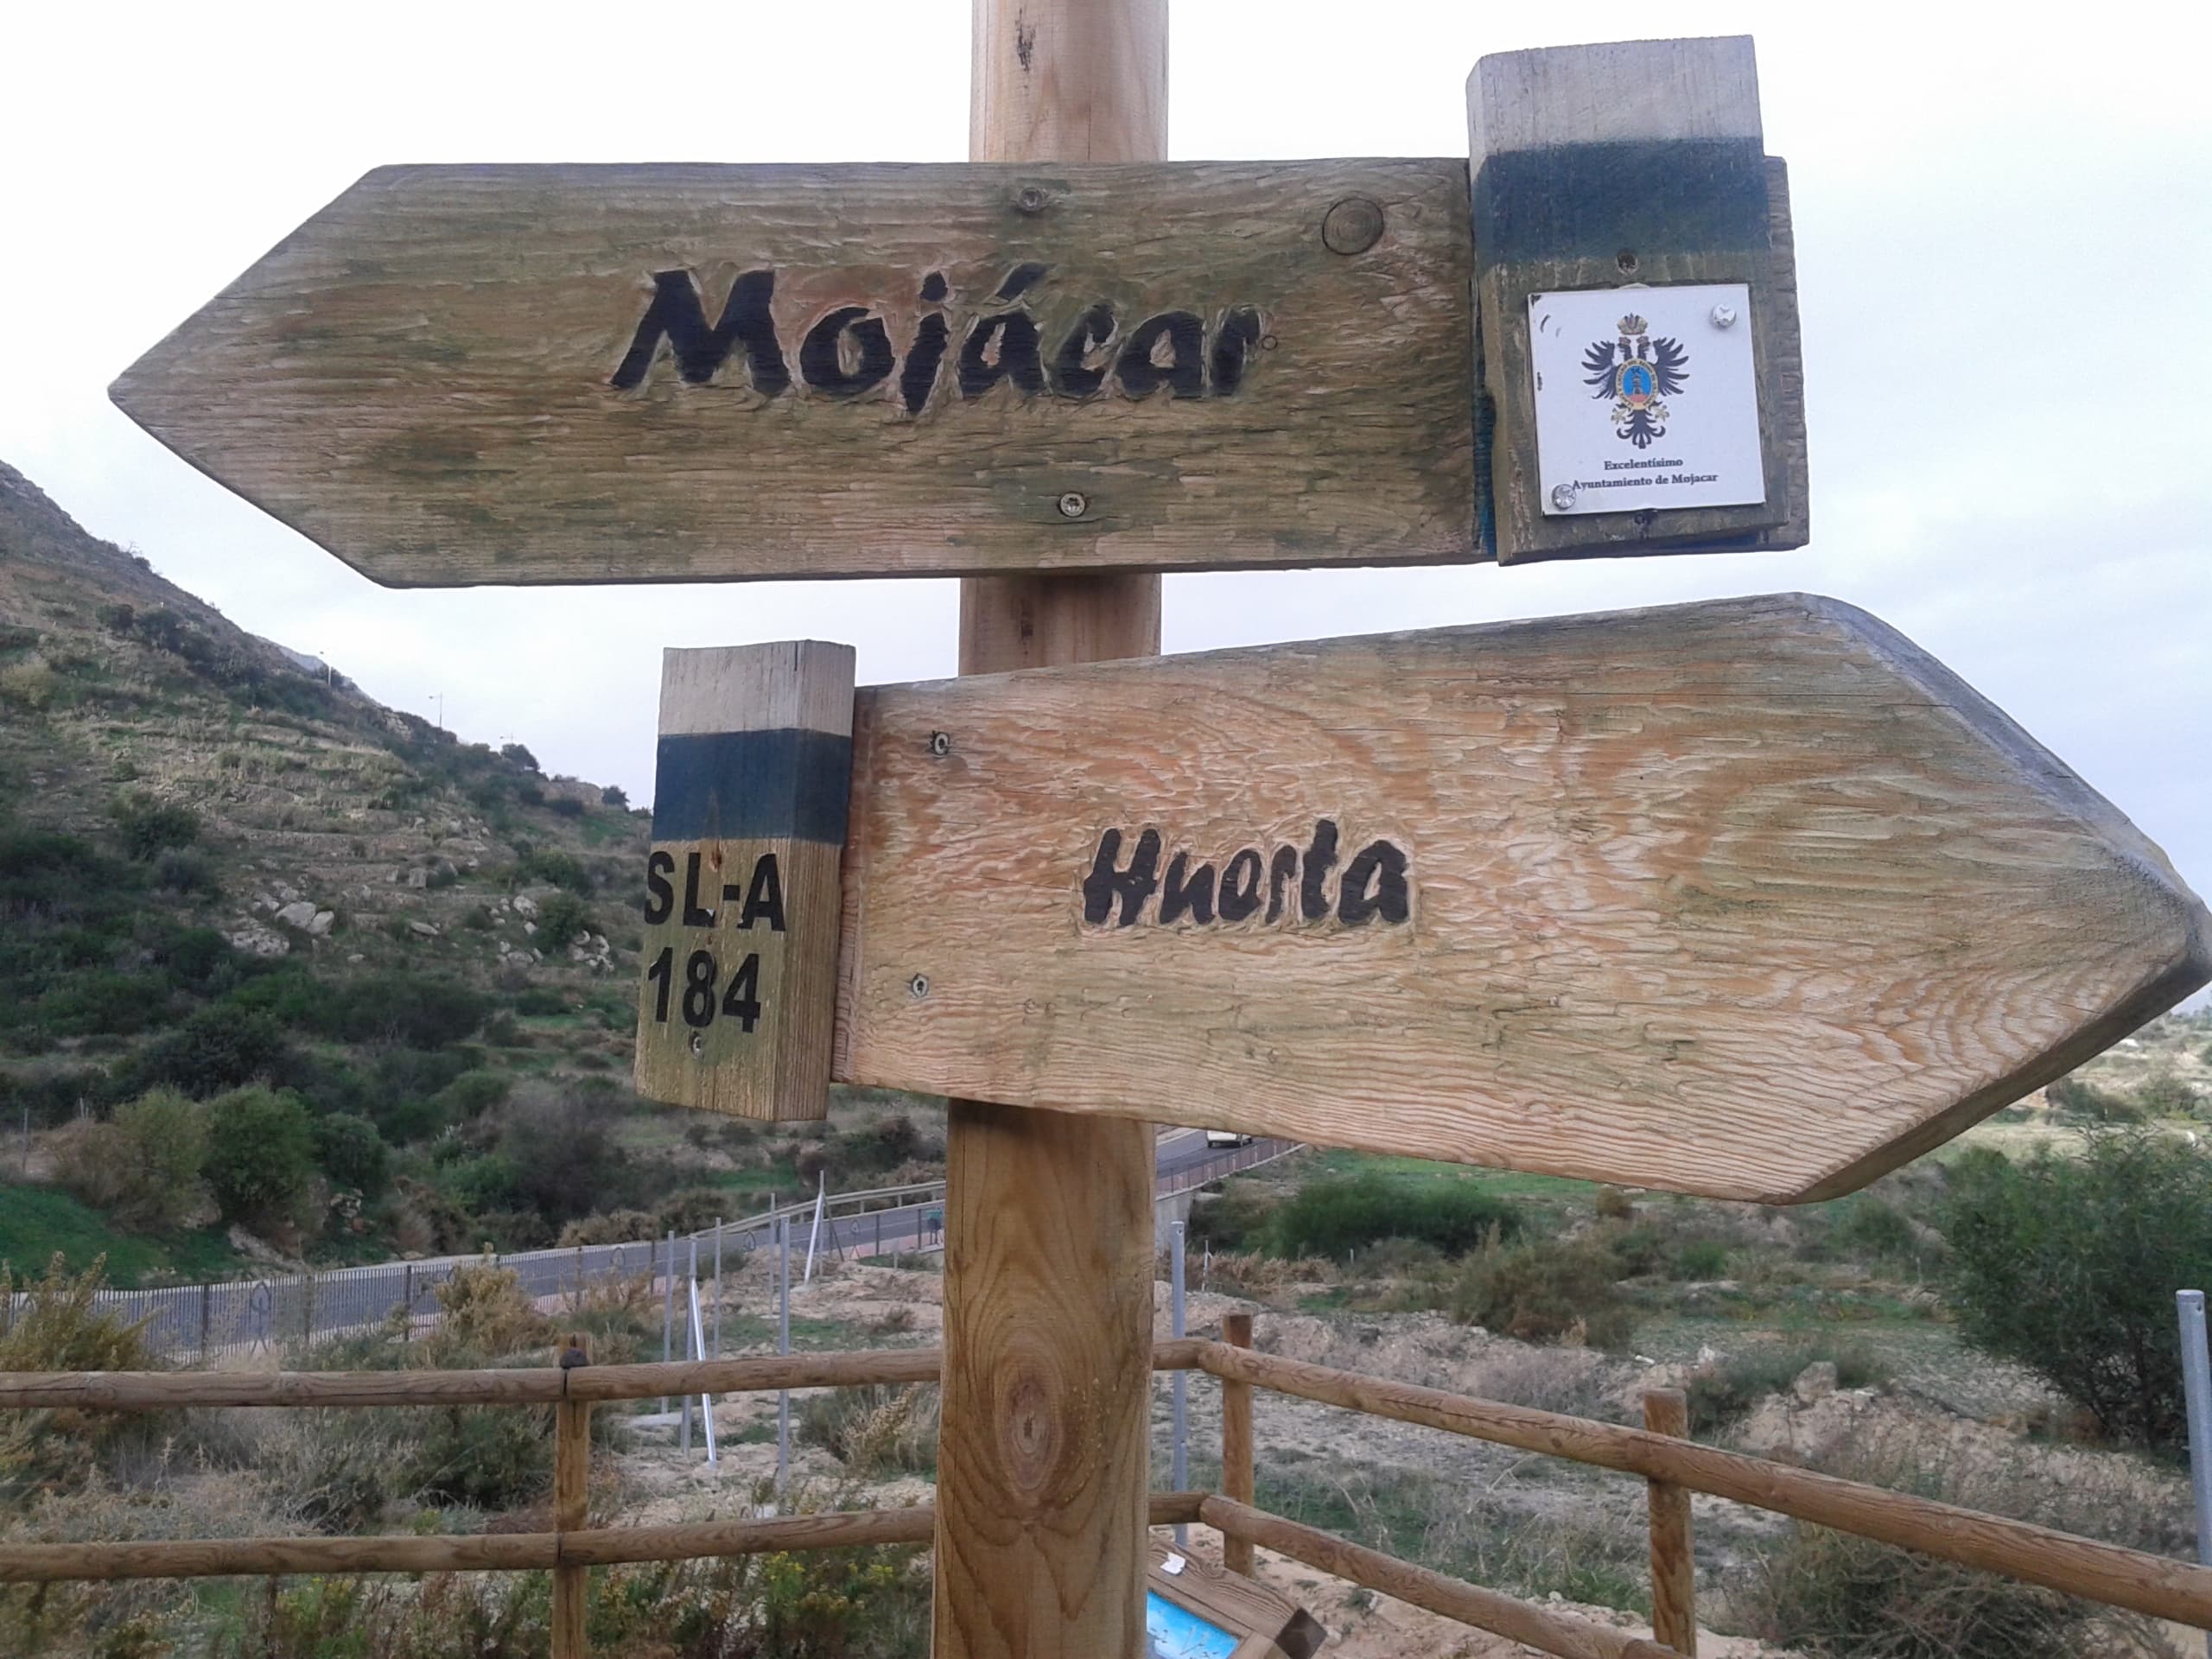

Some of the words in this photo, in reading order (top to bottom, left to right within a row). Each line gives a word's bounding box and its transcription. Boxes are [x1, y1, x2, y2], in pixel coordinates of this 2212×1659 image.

[610, 263, 1262, 416] Mojácar
[1572, 476, 1653, 492] Ayuntamiento
[1655, 474, 1669, 485] de
[1671, 473, 1719, 486] Mojacar
[1603, 457, 1684, 471] Excelentísimo
[644, 850, 786, 932] SL-A
[1083, 818, 1411, 927] Huerta
[648, 947, 762, 1034] 184
